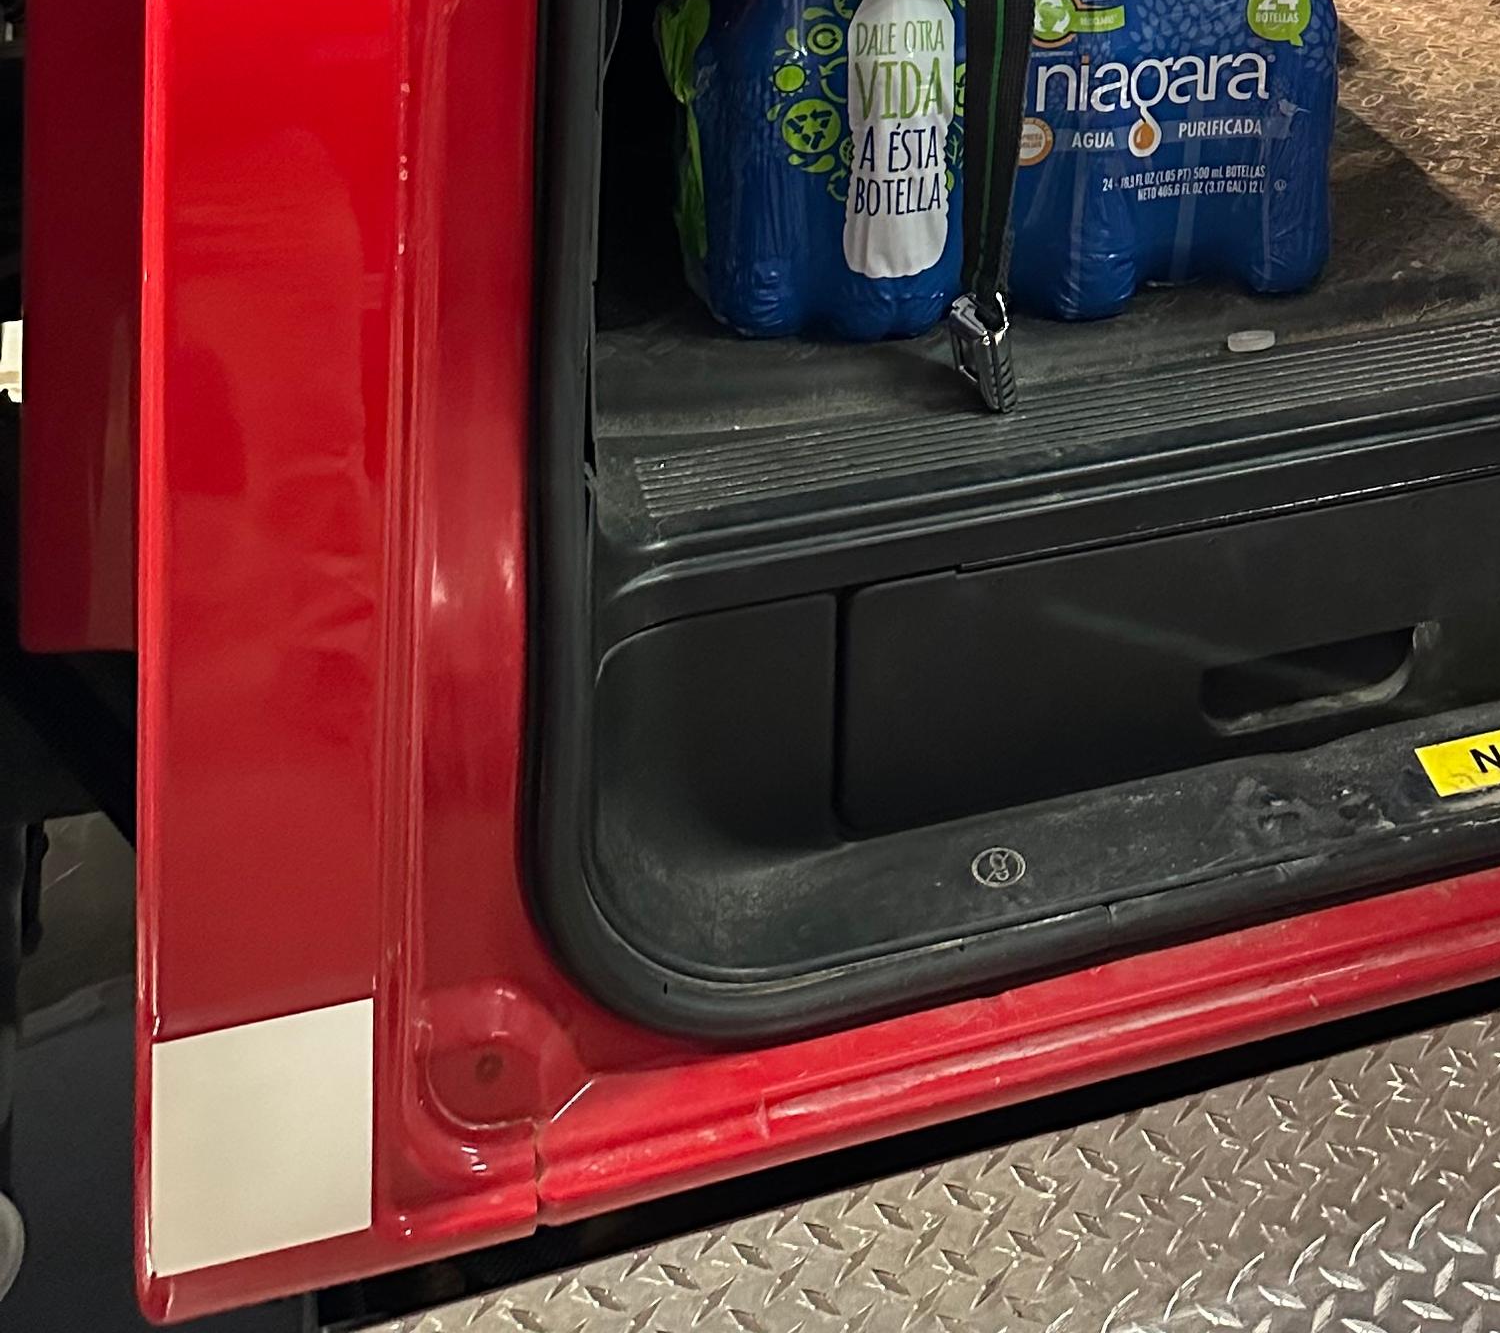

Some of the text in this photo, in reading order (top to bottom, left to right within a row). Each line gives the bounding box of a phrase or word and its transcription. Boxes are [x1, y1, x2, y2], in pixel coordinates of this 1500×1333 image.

[1255, 11, 1299, 25] BOTELLAS
[855, 19, 945, 56] DALE OTRA
[854, 57, 944, 121] VIDA
[1035, 52, 1269, 121] niagara
[859, 123, 939, 173] A ÉSTA
[1071, 118, 1263, 149] AGUA PURIFICADA
[854, 173, 941, 217] BOTELLA
[1102, 178, 1113, 192] 24
[1193, 166, 1210, 180] 500
[1225, 164, 1266, 178] BOTELLAS
[1137, 186, 1157, 202] NETO
